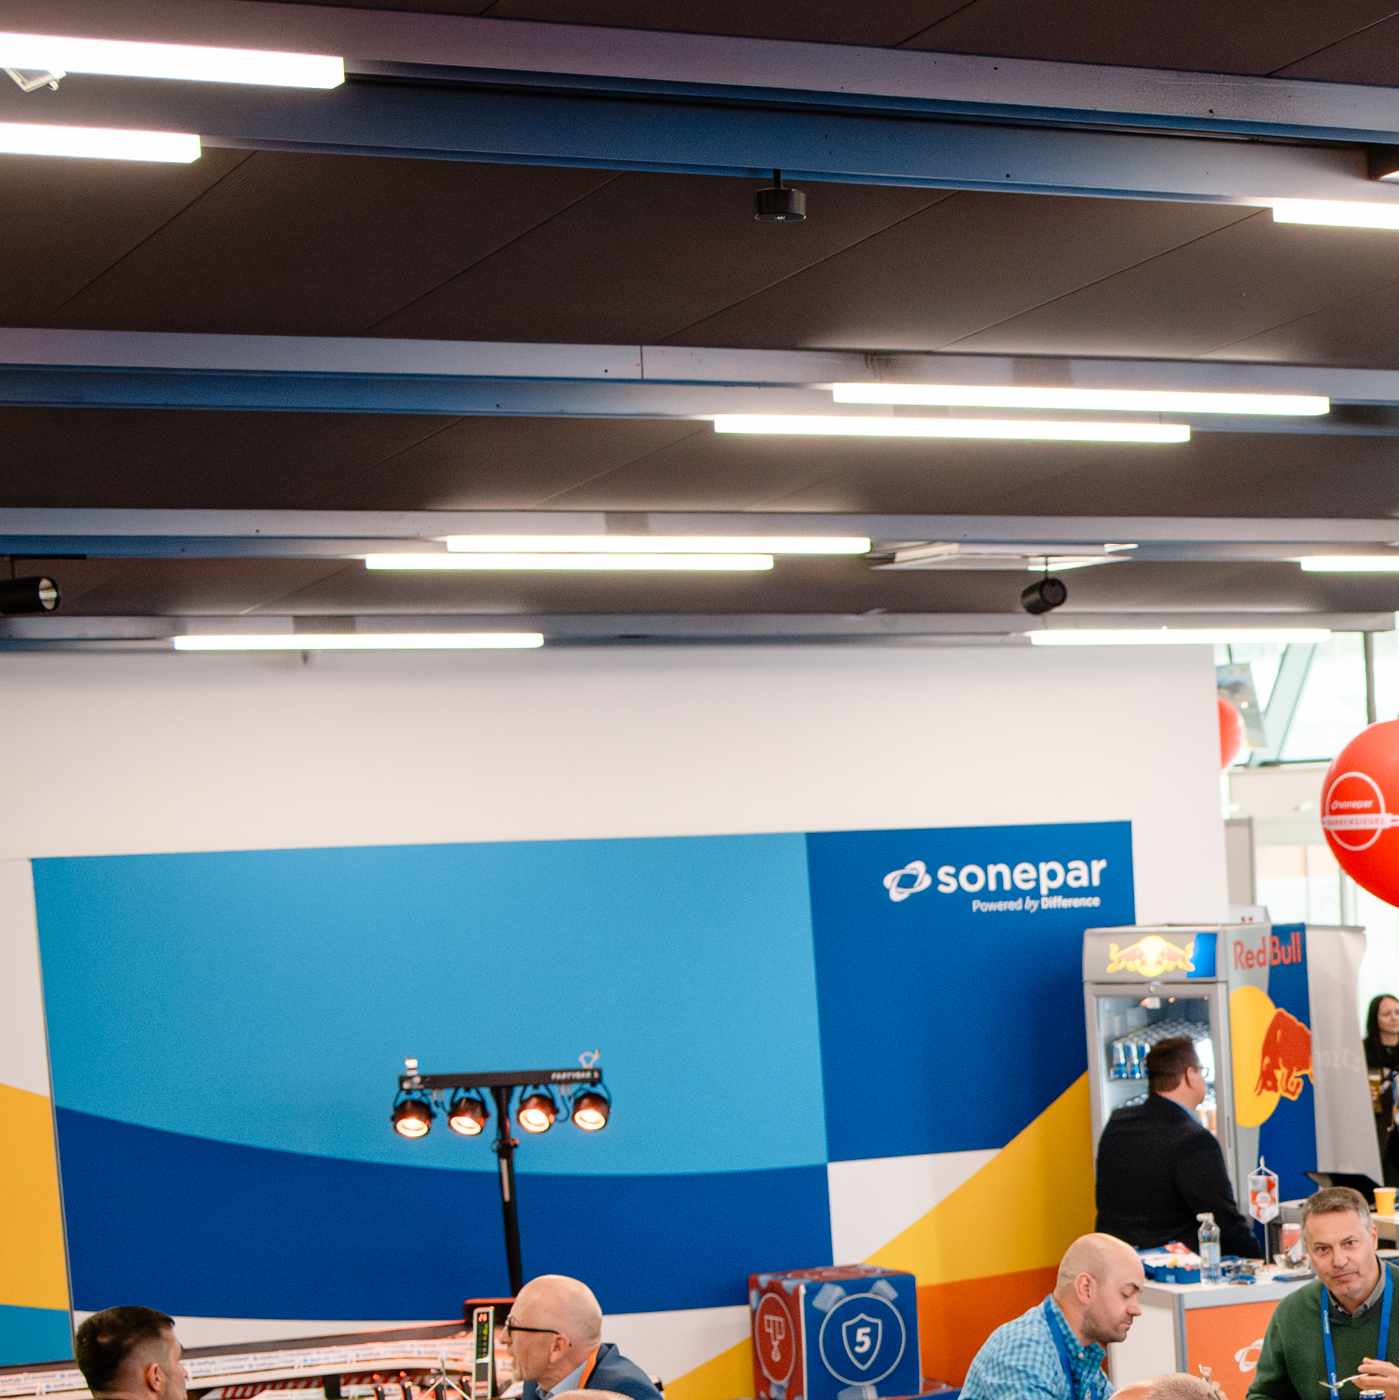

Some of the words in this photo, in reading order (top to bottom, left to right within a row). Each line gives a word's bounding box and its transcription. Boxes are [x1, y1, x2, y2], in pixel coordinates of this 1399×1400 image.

[937, 859, 1107, 896] sonepar
[972, 897, 1023, 913] Powered
[1024, 896, 1039, 913] by
[1040, 895, 1101, 910] Difference
[1233, 936, 1267, 970] Red
[1269, 931, 1302, 966] Bull
[853, 1327, 872, 1354] 5
